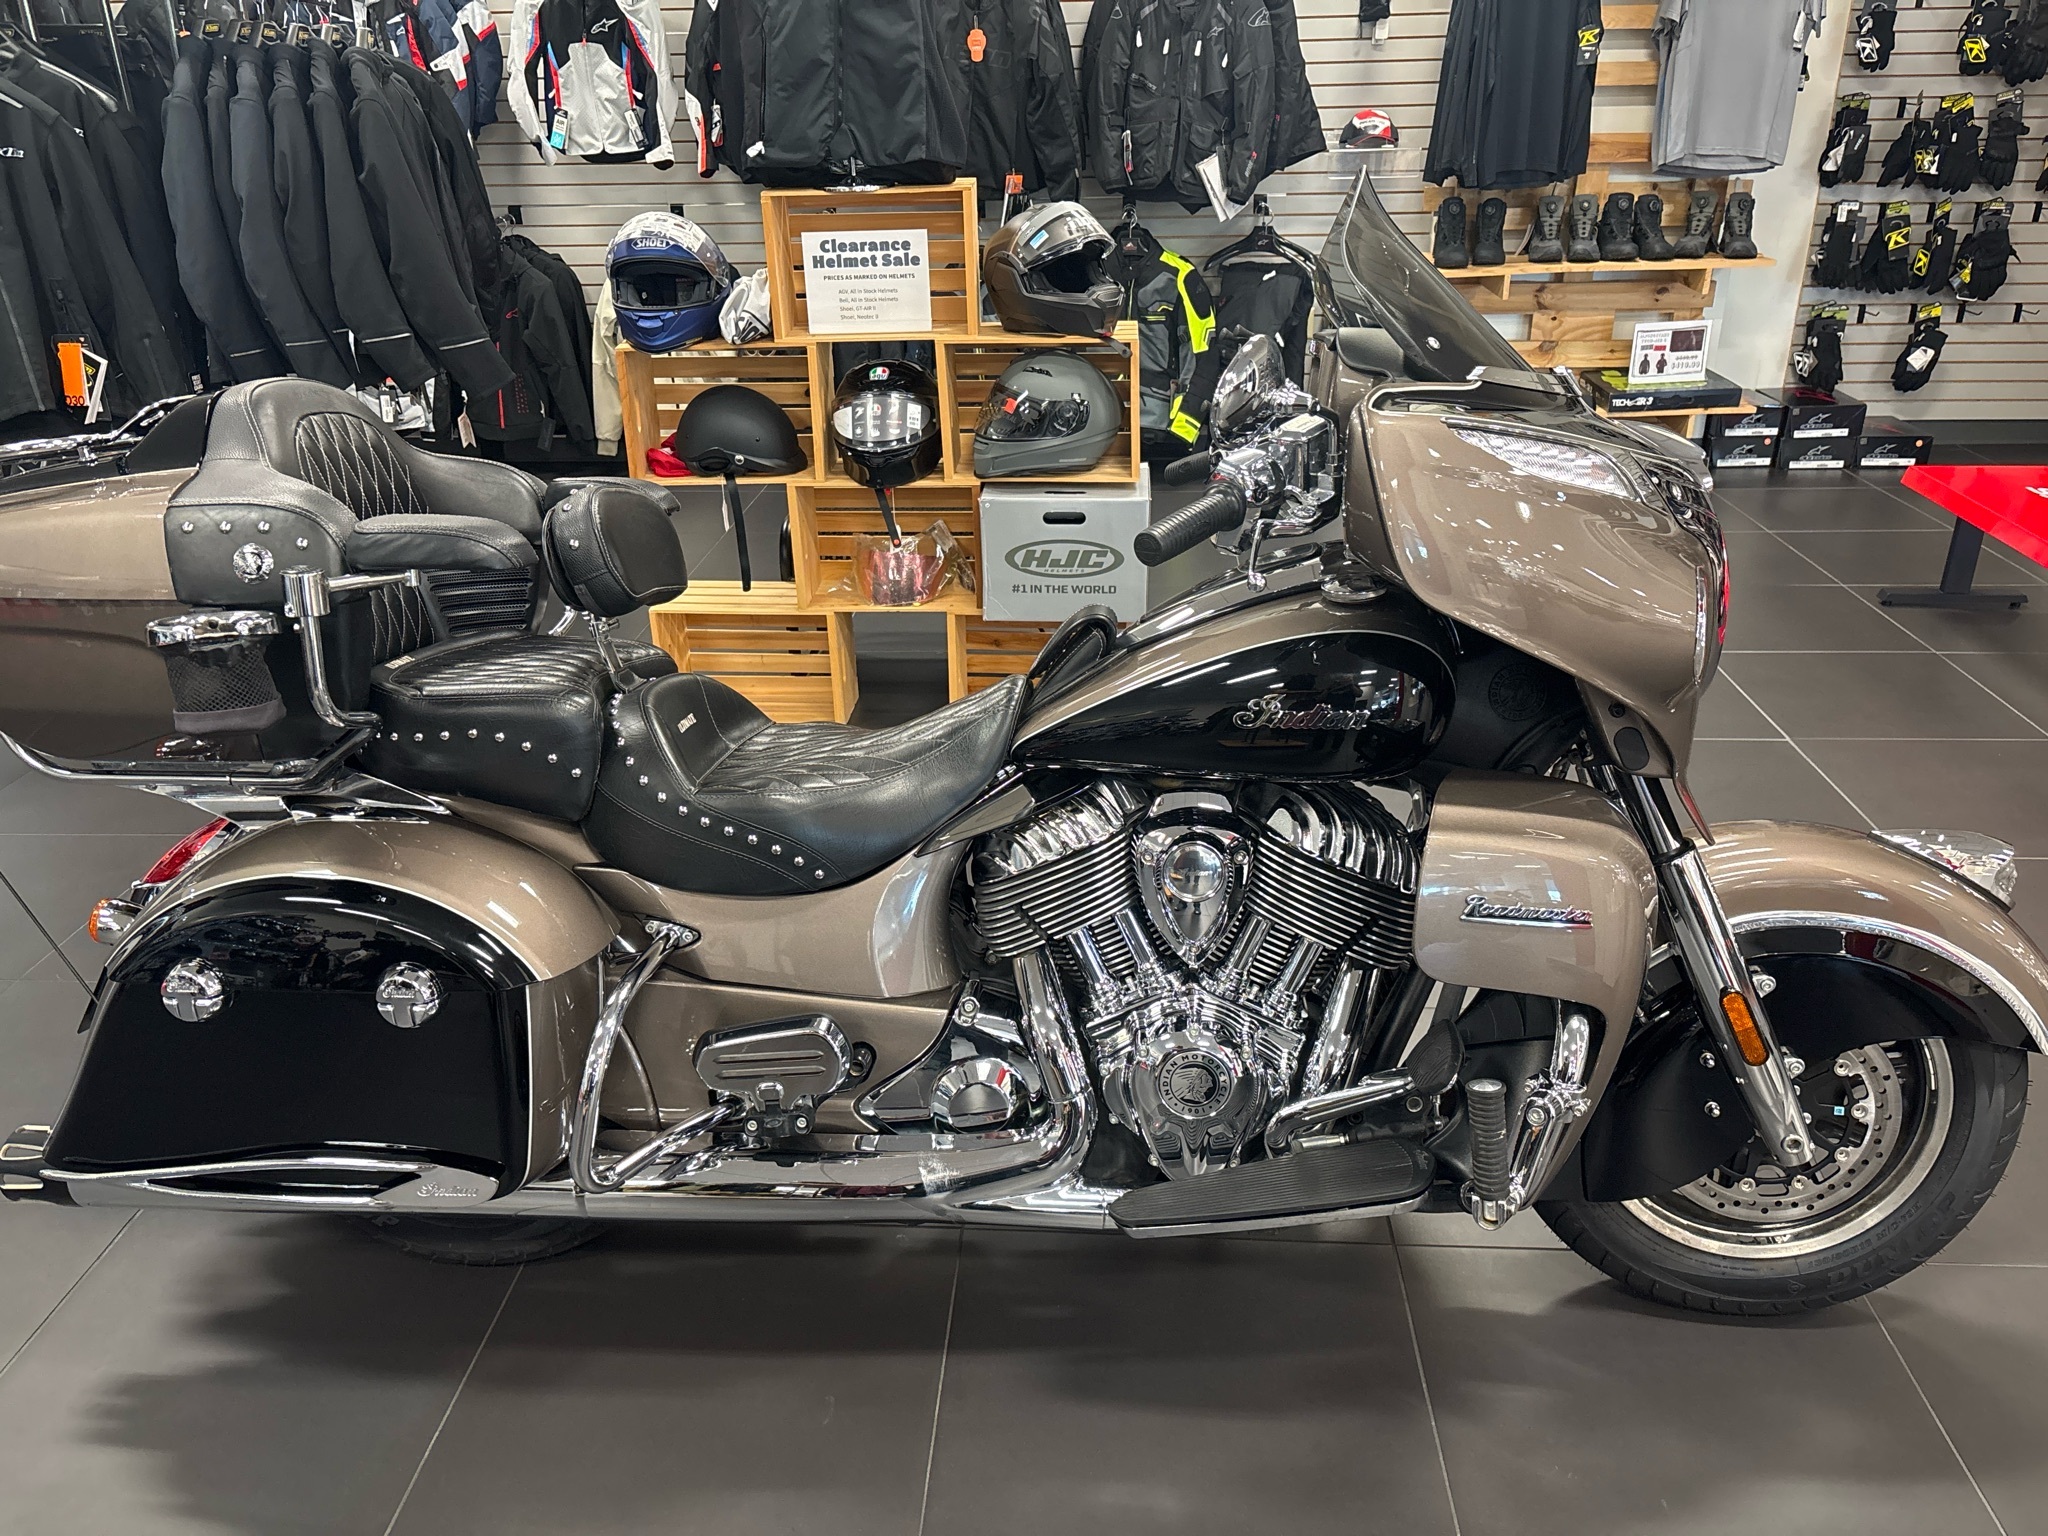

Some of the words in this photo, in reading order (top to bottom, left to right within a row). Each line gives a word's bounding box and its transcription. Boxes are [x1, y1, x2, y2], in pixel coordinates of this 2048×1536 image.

[636, 238, 668, 248] SHOEI
[820, 239, 911, 252] Clearance
[812, 254, 878, 269] Helmet
[881, 252, 921, 267] Sale
[1020, 549, 1109, 568] HJC
[1012, 584, 1028, 594] #1
[1030, 584, 1042, 594] IN
[1044, 584, 1068, 594] THE
[1071, 585, 1116, 594] WORLD
[1232, 693, 1371, 730] Indian
[1465, 894, 1593, 921] Roadmaster
[1162, 1061, 1178, 1100] INDIAN
[1182, 1054, 1228, 1104] MOTORCYCLE
[416, 1182, 478, 1197] Indian
